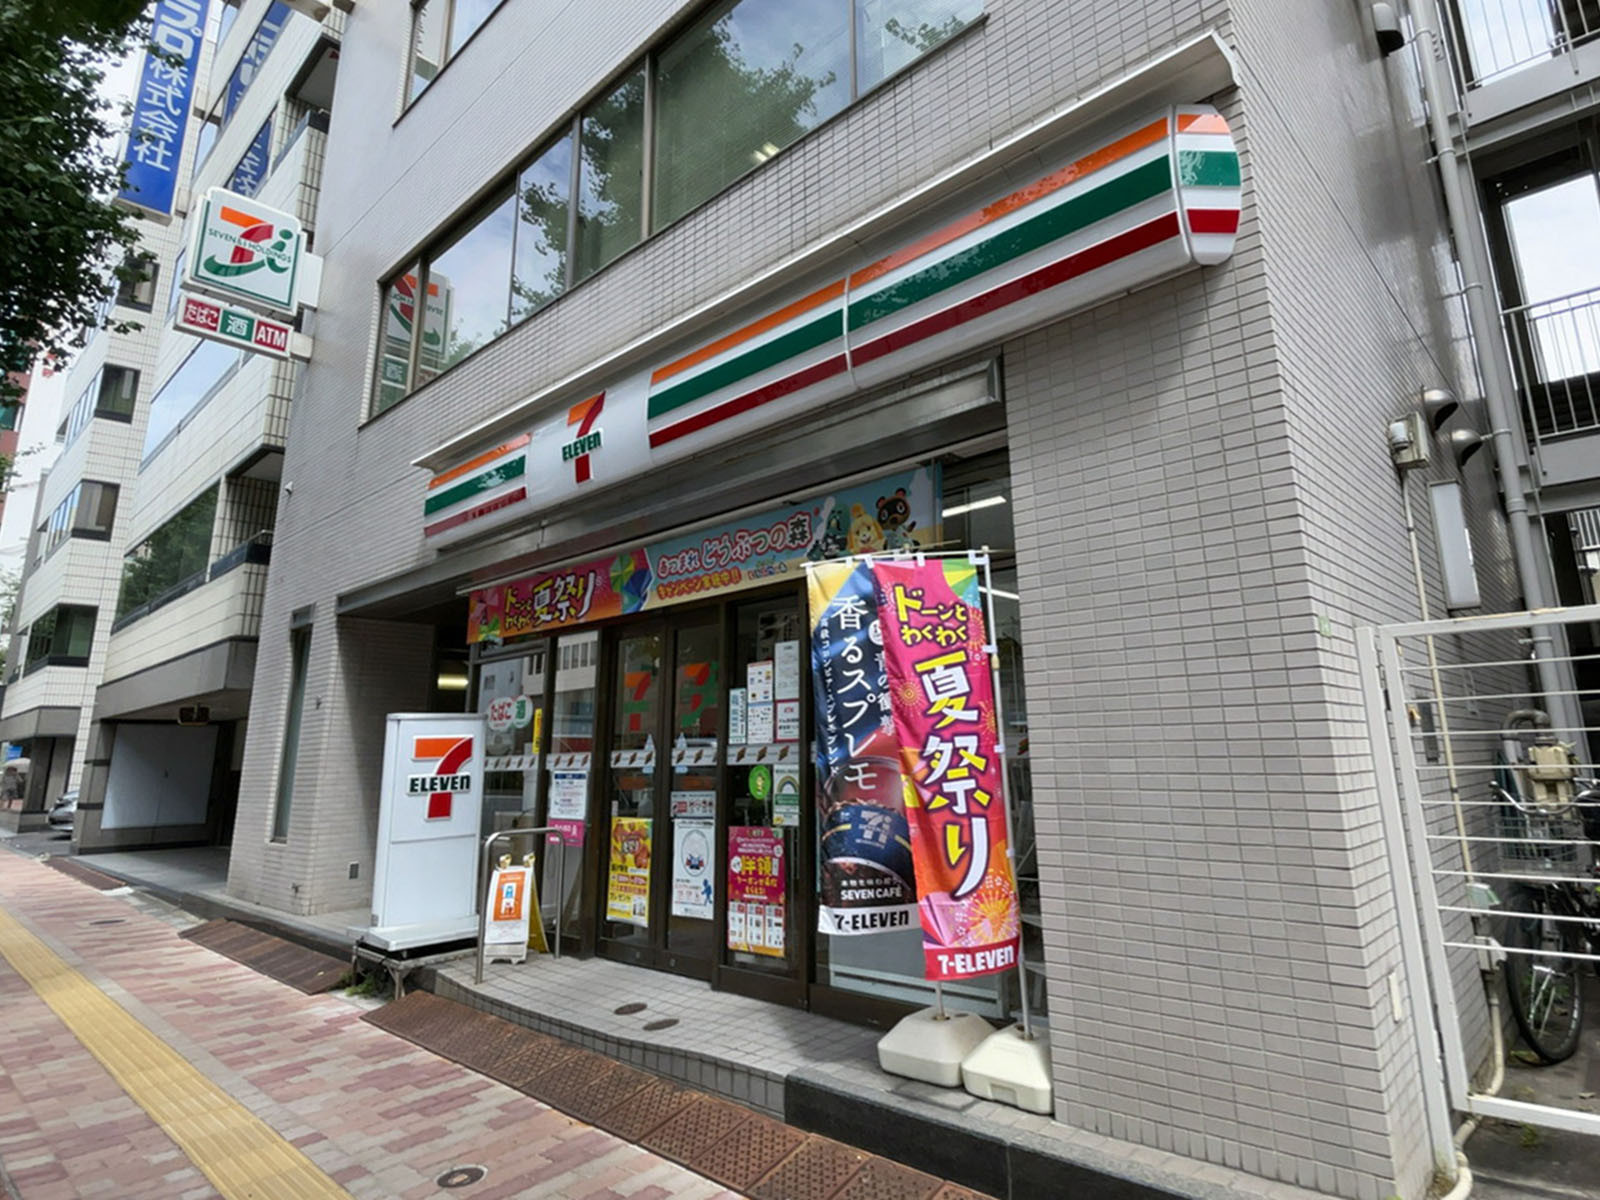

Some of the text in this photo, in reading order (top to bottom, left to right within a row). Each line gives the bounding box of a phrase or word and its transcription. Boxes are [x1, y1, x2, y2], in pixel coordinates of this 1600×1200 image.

[133, 0, 203, 172] プロ株式会社
[185, 303, 286, 347] たばこ 酒 ATM
[532, 570, 596, 627] 夏祭り
[894, 584, 968, 623] ドーンと
[901, 624, 968, 647] わくわく
[831, 594, 878, 790] 香るスプレモ
[915, 650, 991, 898] 夏祭り
[841, 885, 903, 901] SEVEN CAFÉ
